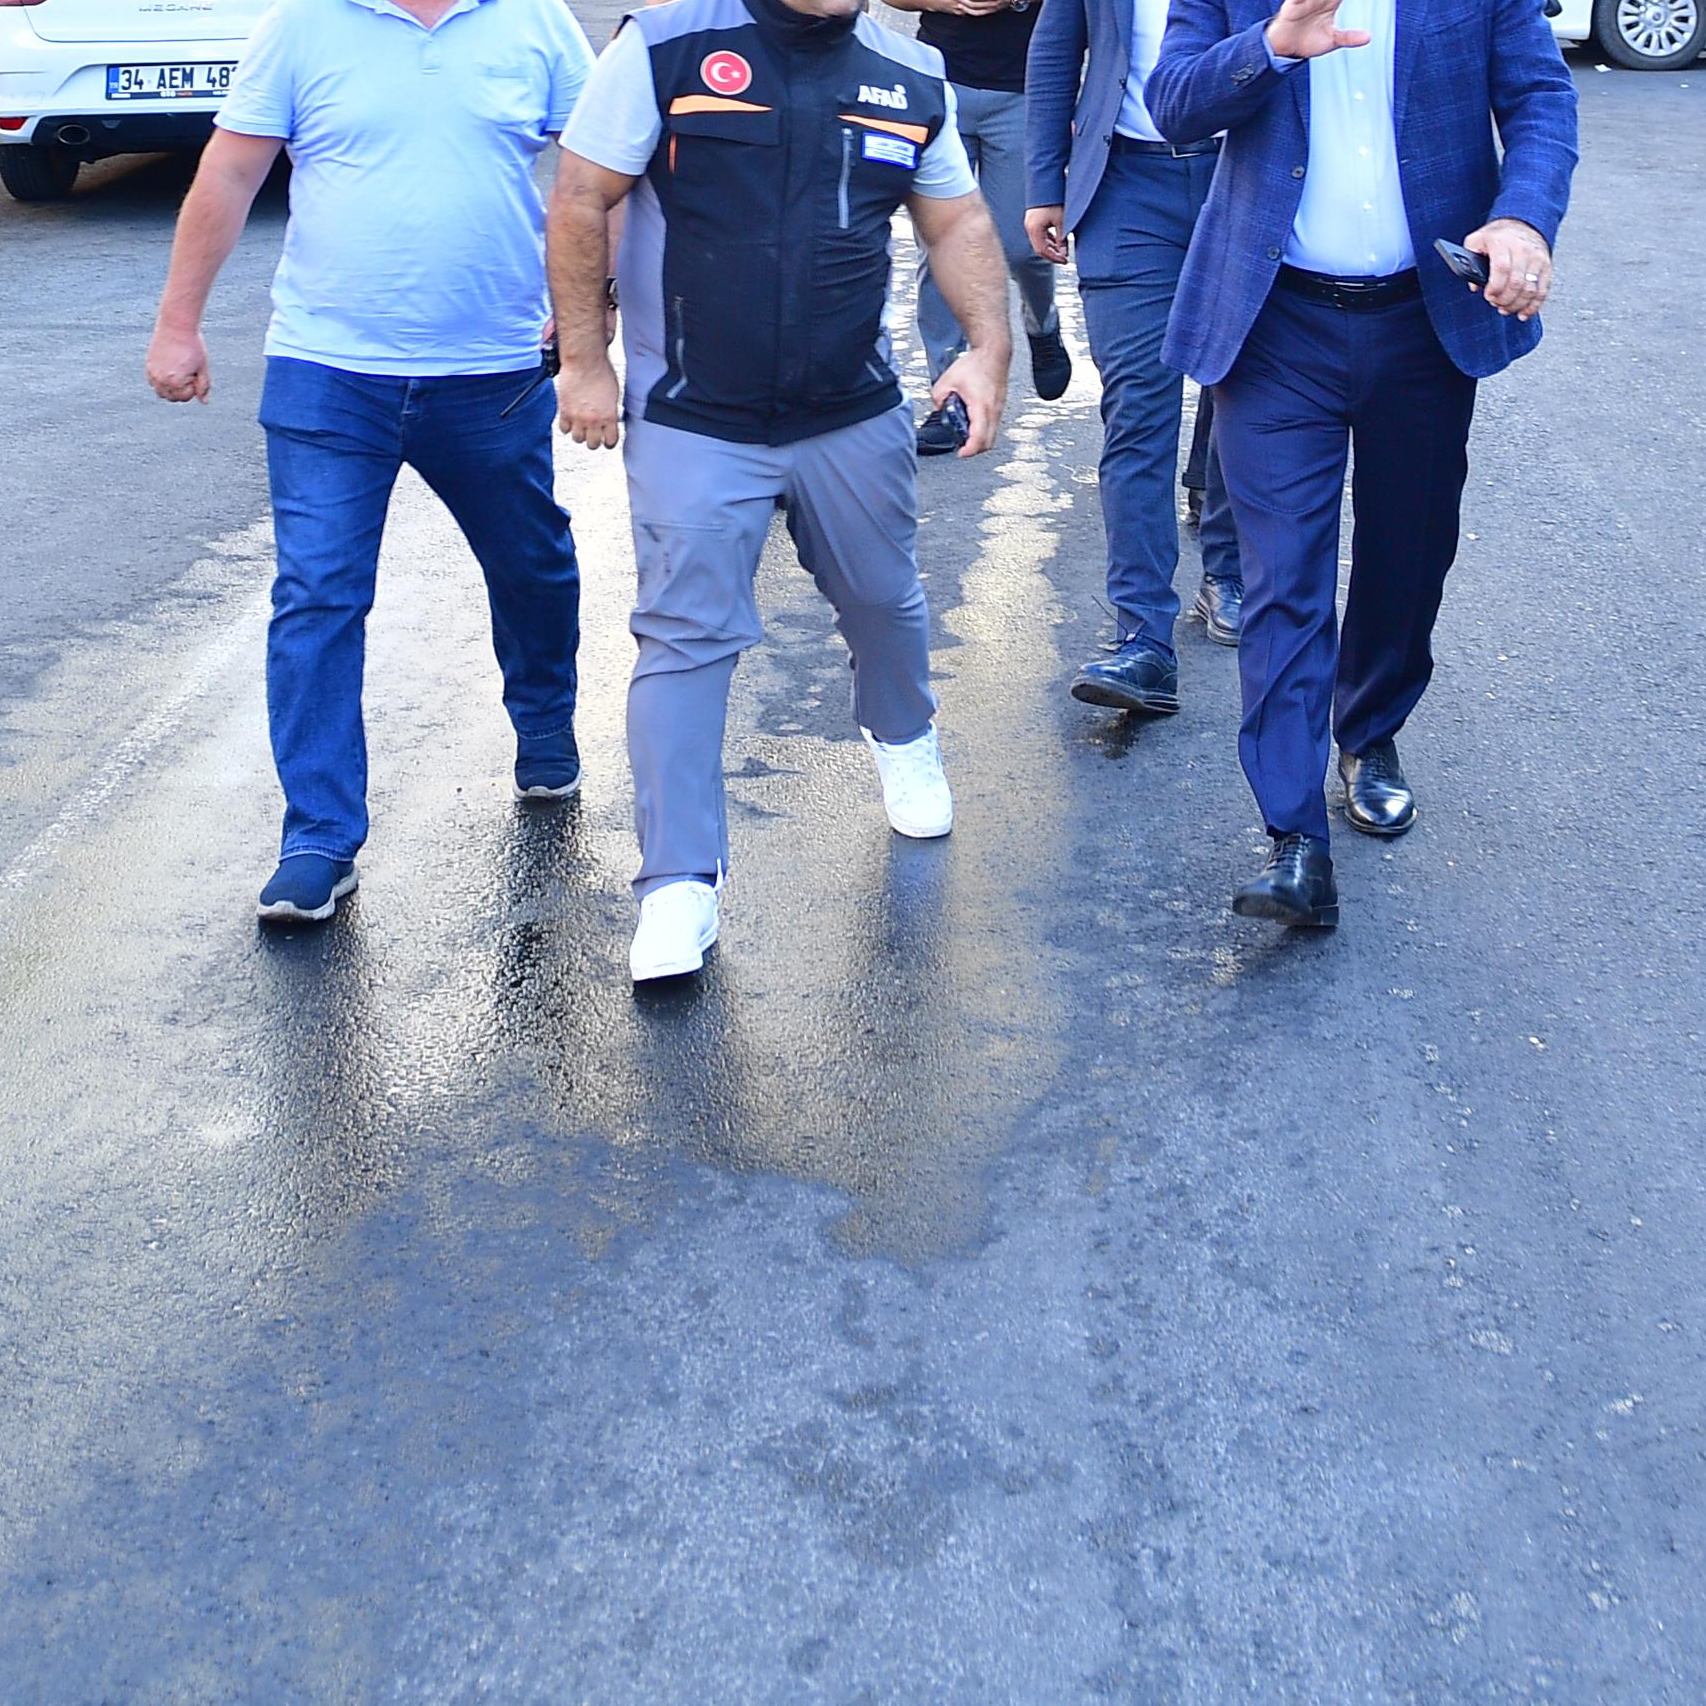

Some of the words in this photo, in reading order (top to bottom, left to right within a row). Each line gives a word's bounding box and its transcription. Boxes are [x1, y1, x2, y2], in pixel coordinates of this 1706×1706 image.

[121, 69, 144, 90] 34
[156, 67, 195, 89] AEM
[206, 65, 238, 88] 48
[857, 84, 908, 110] AFAD
